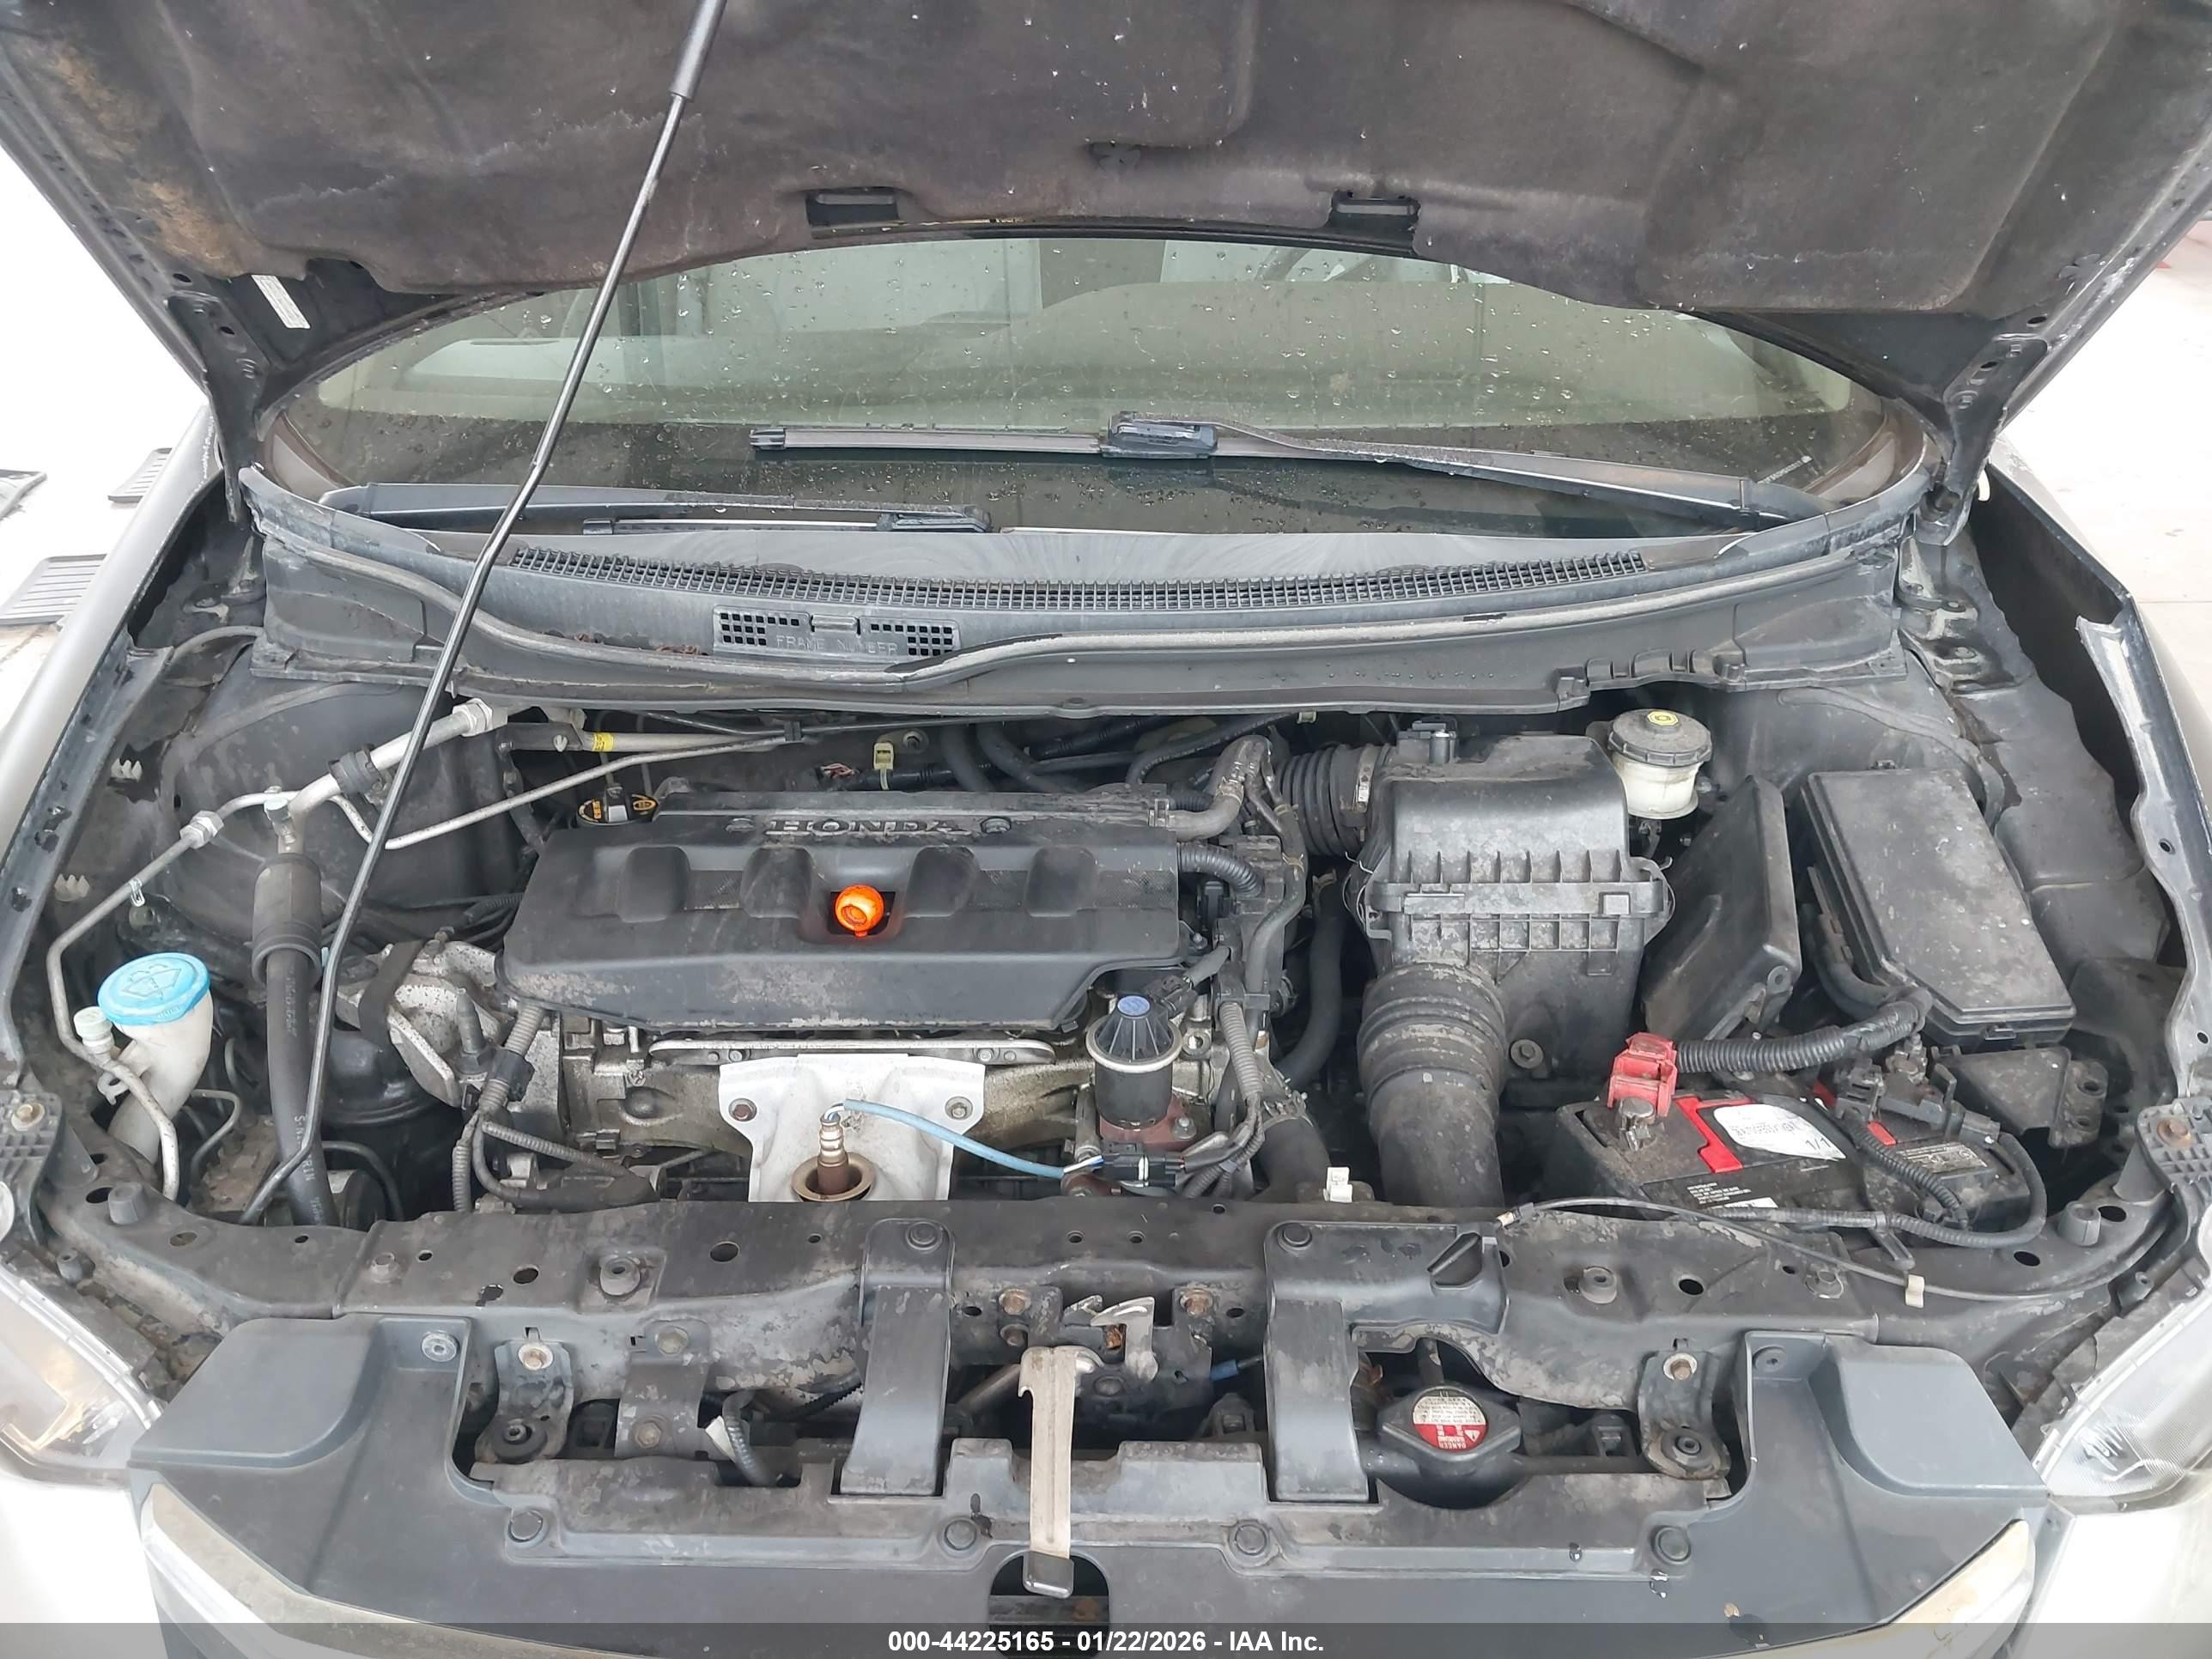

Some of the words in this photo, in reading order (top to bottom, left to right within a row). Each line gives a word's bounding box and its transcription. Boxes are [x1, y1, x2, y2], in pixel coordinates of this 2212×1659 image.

[776, 635, 825, 651] FRAME
[765, 818, 972, 836] HONDA
[1805, 1137, 1832, 1151] 1/1
